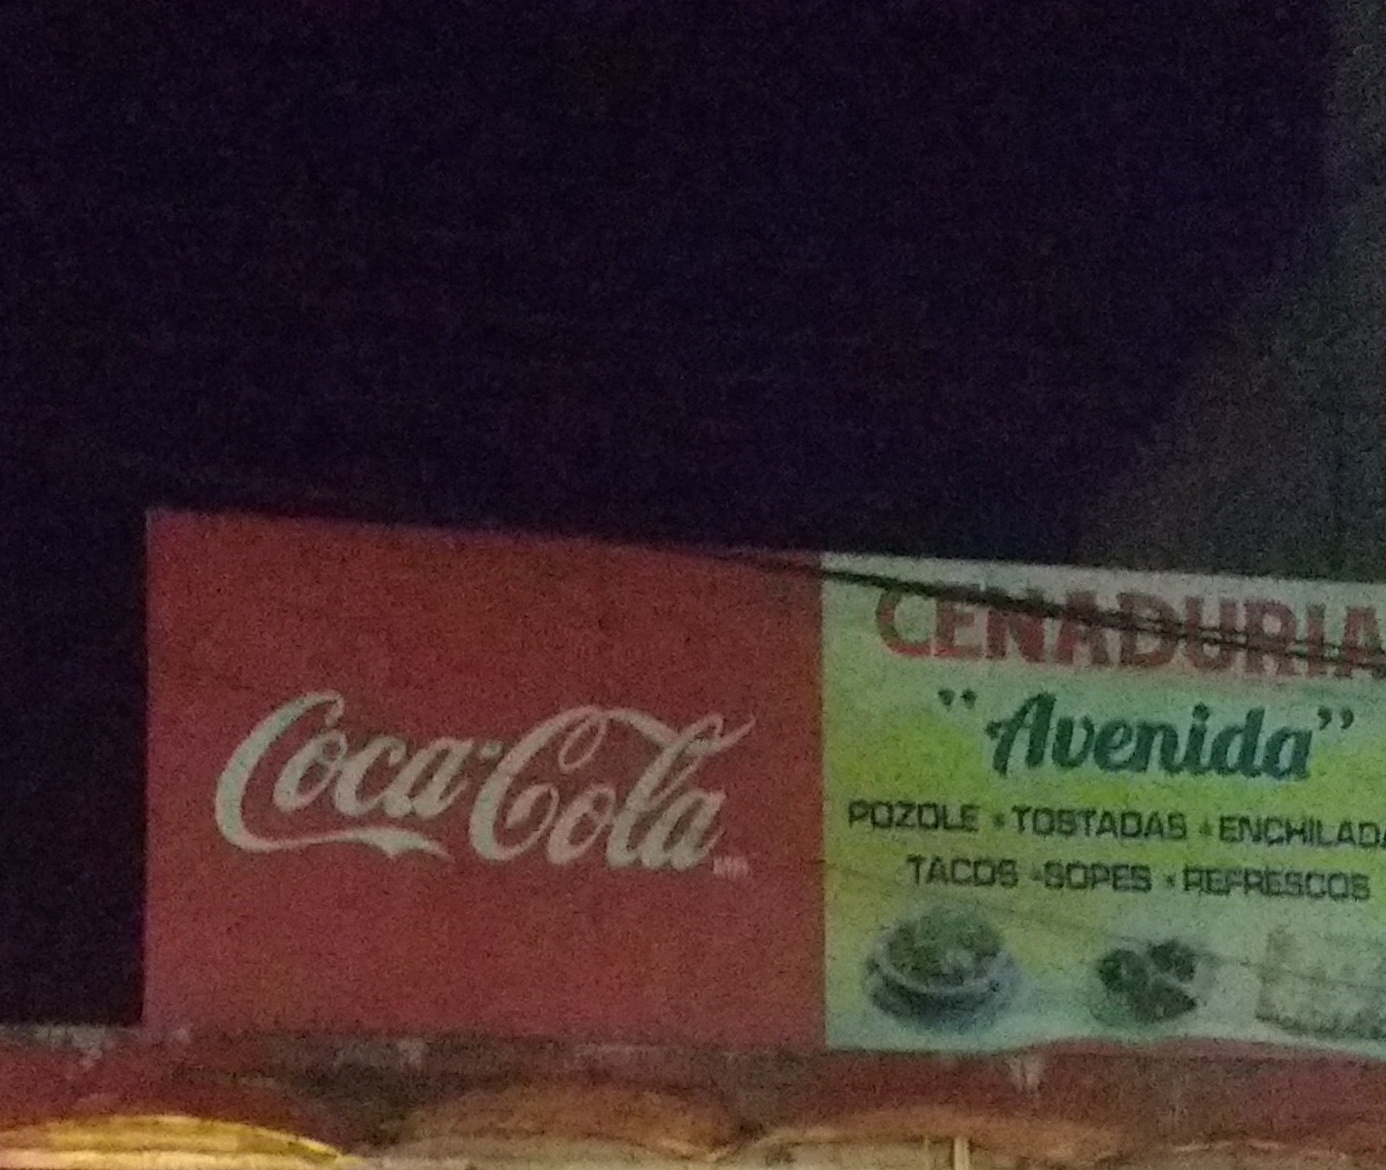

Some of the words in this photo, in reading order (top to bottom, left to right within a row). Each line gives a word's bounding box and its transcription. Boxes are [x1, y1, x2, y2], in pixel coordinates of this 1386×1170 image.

[849, 802, 980, 833] POZOLE
[1011, 806, 1187, 840] TOSTADAS
[907, 854, 1019, 885] TACOS
[1042, 861, 1153, 893] SOPES
[1183, 867, 1372, 901] REFRESCOS
